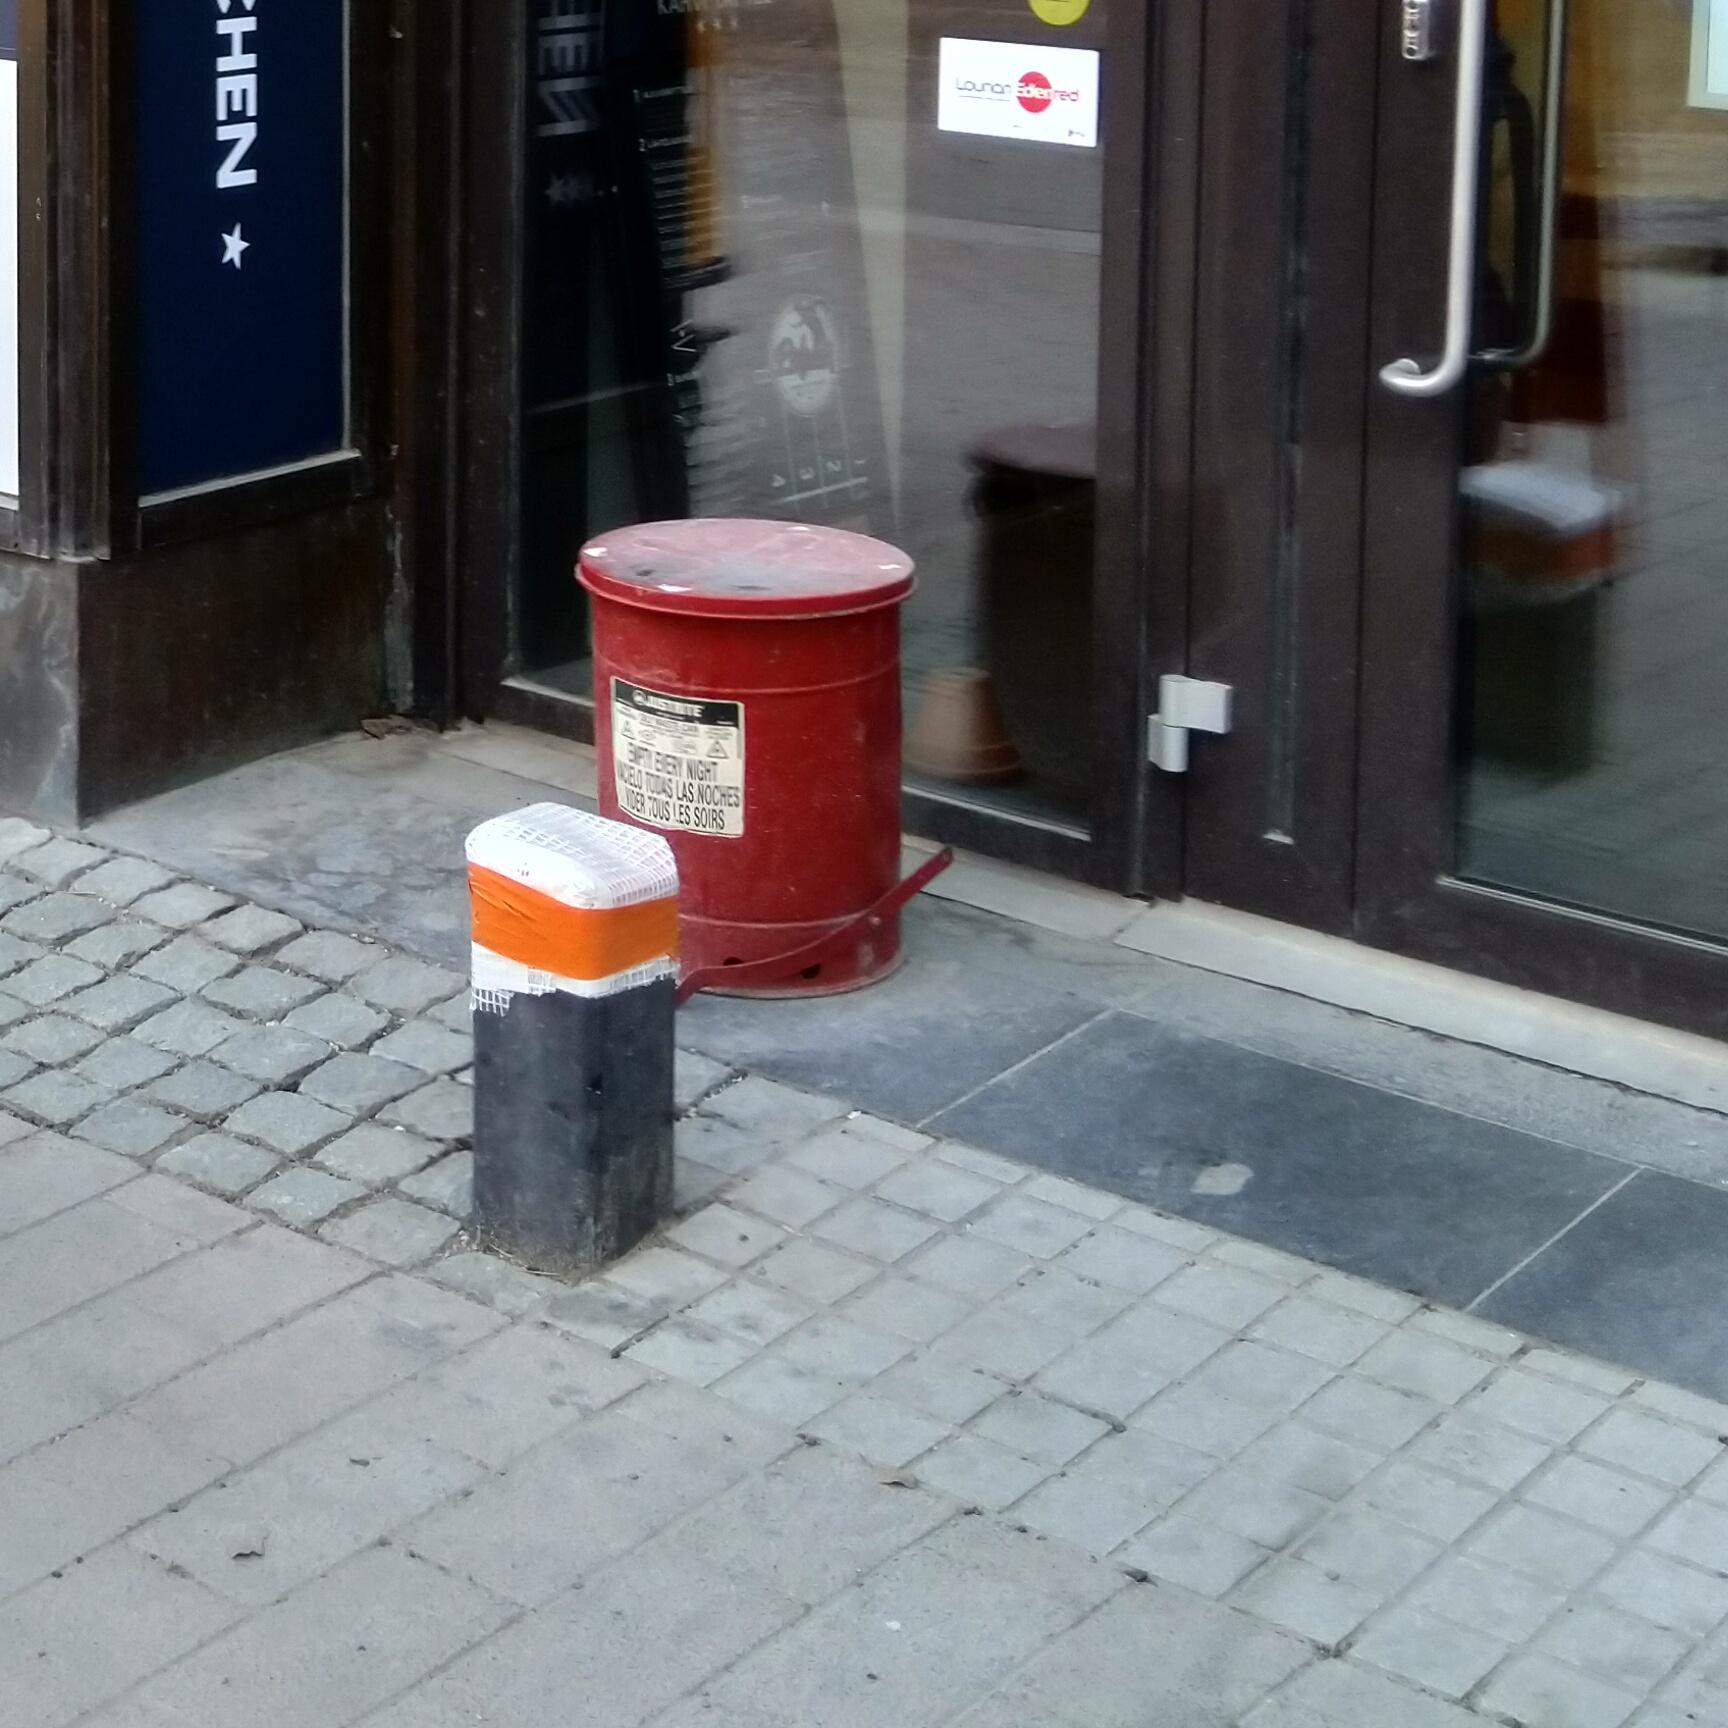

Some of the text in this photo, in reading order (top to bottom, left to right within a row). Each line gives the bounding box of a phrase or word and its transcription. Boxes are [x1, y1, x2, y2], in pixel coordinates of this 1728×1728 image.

[1017, 79, 1079, 102] Edenred
[687, 759, 719, 783] NIGHT
[676, 779, 694, 804] LAS
[697, 784, 740, 809] NOCHES
[647, 796, 671, 821] TOUS
[673, 802, 692, 826] LES
[693, 807, 726, 831] SOIRS
